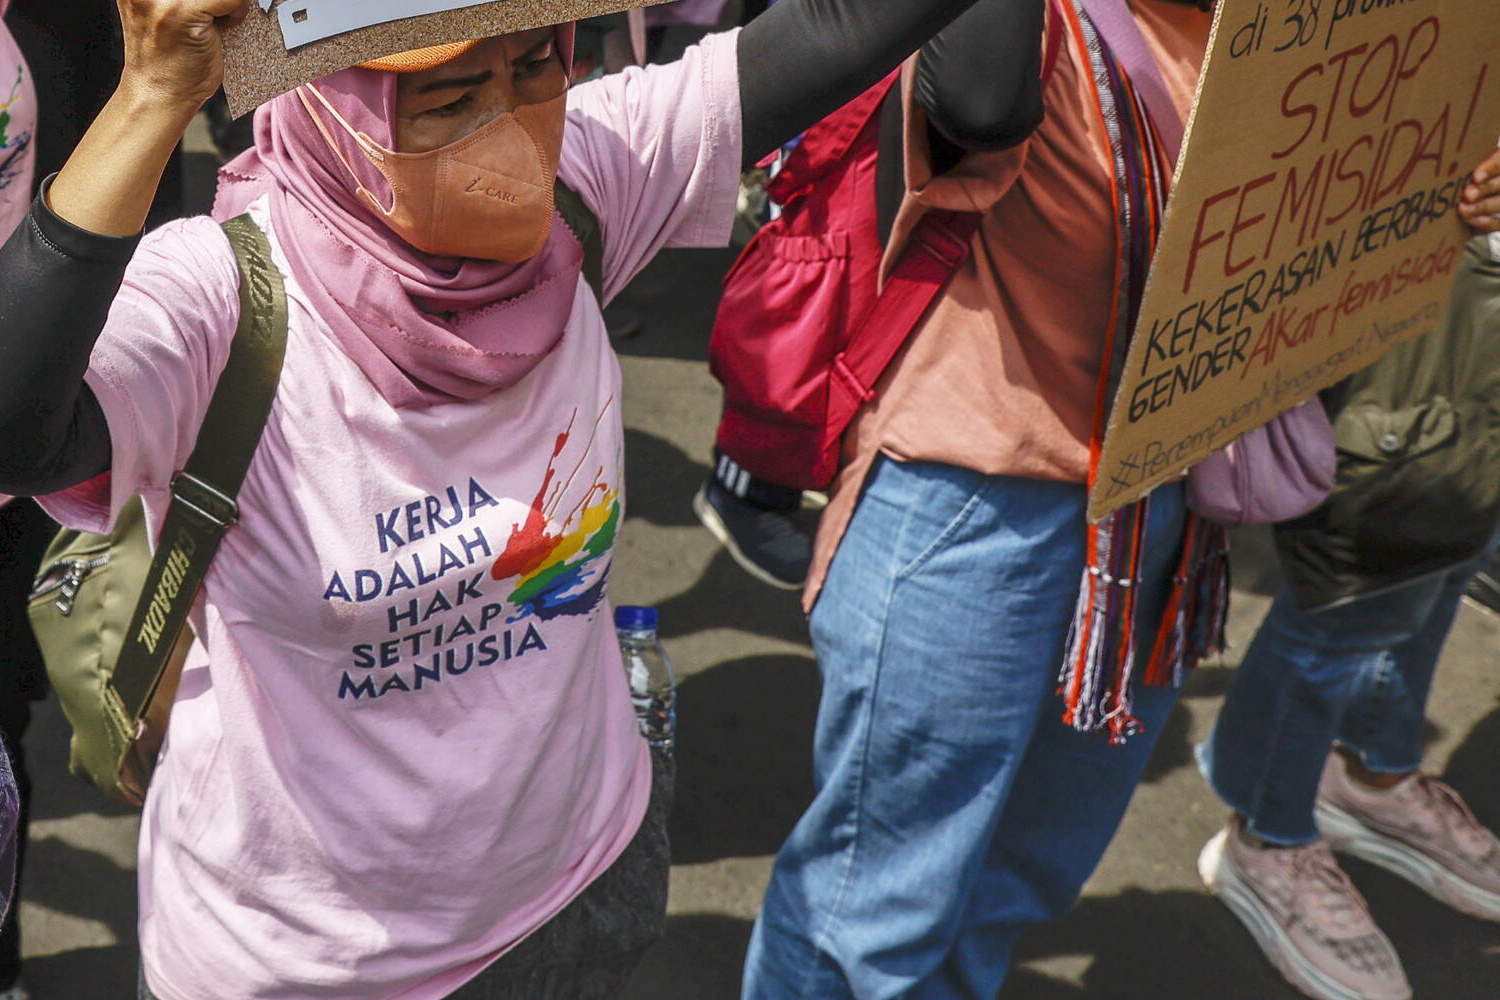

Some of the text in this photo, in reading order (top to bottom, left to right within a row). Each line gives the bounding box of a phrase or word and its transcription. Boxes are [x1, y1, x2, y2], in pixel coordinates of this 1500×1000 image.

[1230, 2, 1268, 59] di
[1271, 15, 1440, 160] STOP
[1181, 62, 1489, 296] FEMISIDA!
[1140, 228, 1346, 377] KEKERASAN
[1127, 326, 1252, 424] GENDER
[374, 475, 500, 554] KERJA
[323, 526, 493, 603] ADALAH
[387, 569, 488, 634] HAK
[337, 621, 548, 700] MANUSIA
[352, 602, 503, 670] SETIAP
